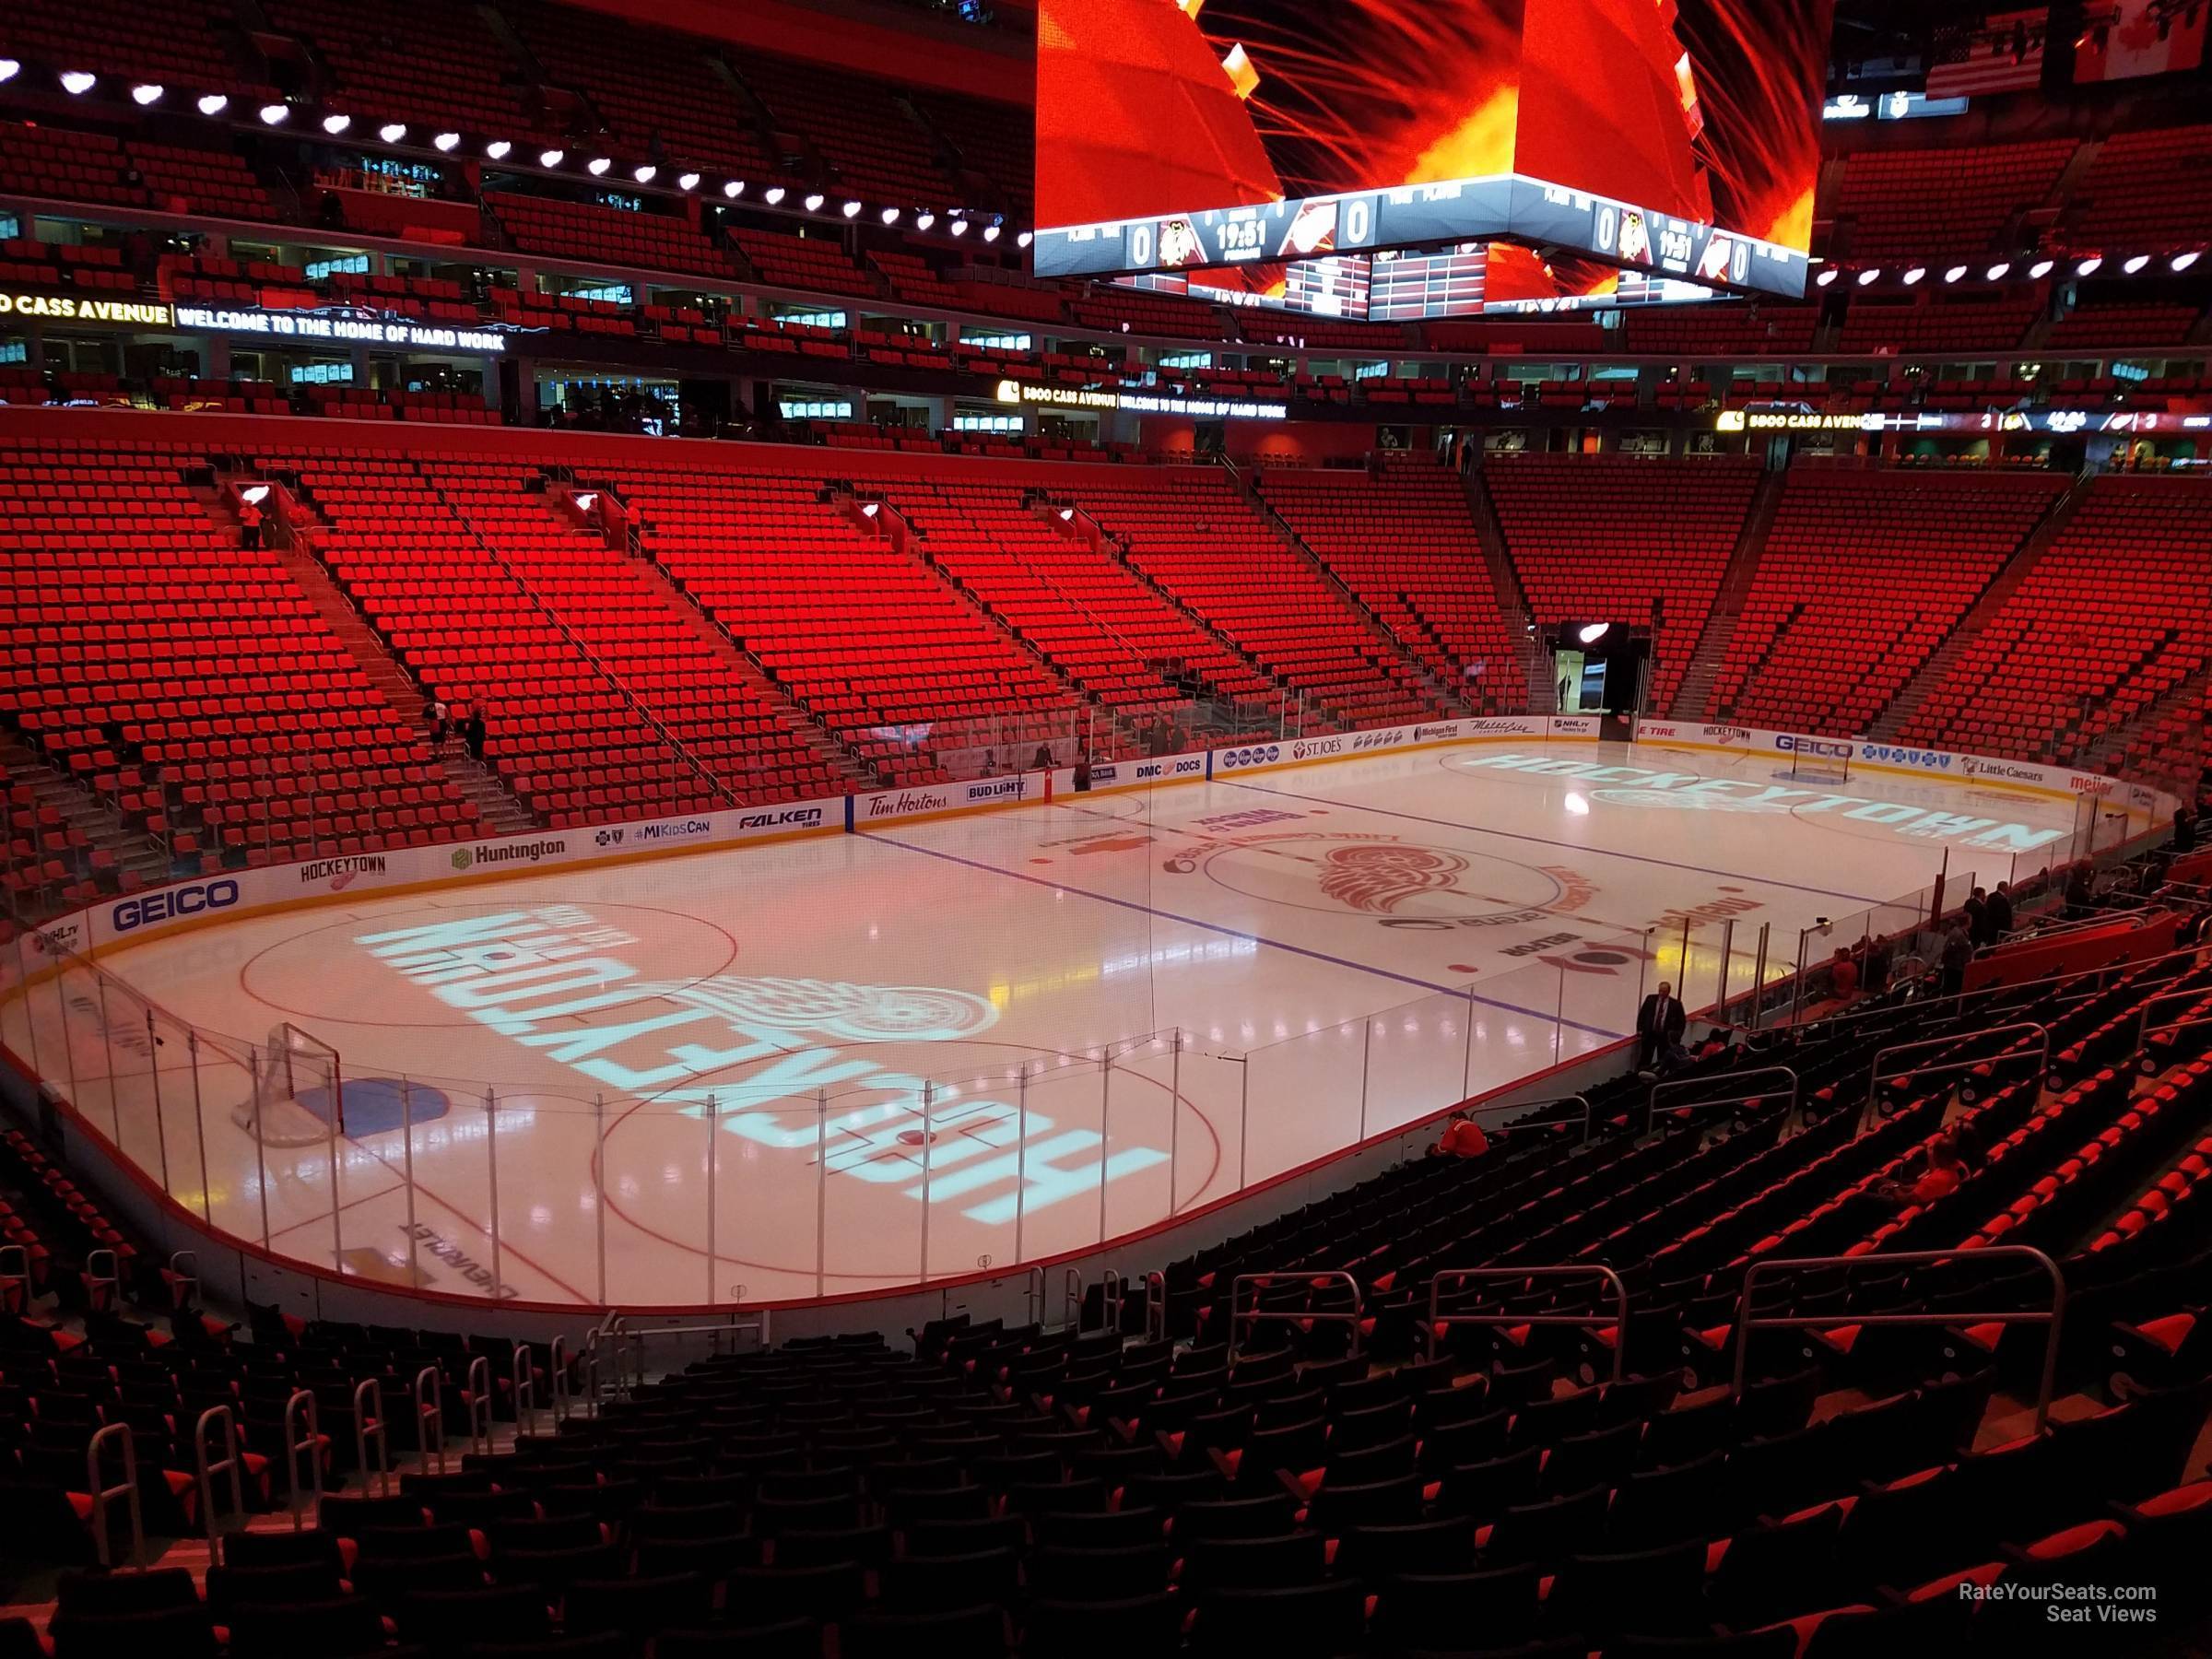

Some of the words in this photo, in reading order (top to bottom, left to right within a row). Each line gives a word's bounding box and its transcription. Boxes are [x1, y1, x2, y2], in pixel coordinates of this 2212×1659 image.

[1347, 200, 1369, 243] 0
[1598, 207, 1615, 250] 0
[1133, 226, 1151, 265] 0
[1734, 242, 1748, 281] 0
[16, 296, 76, 318] CASS
[78, 300, 169, 324] AVENUE
[177, 308, 268, 333] WELCOME
[270, 315, 294, 334] TO
[295, 318, 332, 336] THE
[334, 321, 383, 341] HOME
[385, 324, 409, 342] OF
[410, 328, 456, 347] HARD
[457, 331, 505, 350] WORK
[1078, 392, 1116, 407] AVENUE
[1651, 727, 1676, 736] TIRE
[1775, 735, 1853, 759] GEICO
[1136, 765, 1161, 778] DMC
[1176, 759, 1201, 773] DOCS
[1979, 762, 2006, 776] Little
[2006, 767, 2043, 782] Caesars
[969, 785, 992, 798] BUD
[1462, 754, 2065, 848] HOCKEYTOWN
[869, 795, 894, 817] Tim
[896, 792, 947, 813] Hortons
[739, 807, 822, 830] FALKEN
[476, 840, 565, 863] Huntington
[301, 856, 385, 882] HOCKEYTOWN
[112, 879, 240, 932] GEICO
[1497, 932, 1583, 957] BELFOR
[353, 911, 1172, 1226] HOCKEYTOWN
